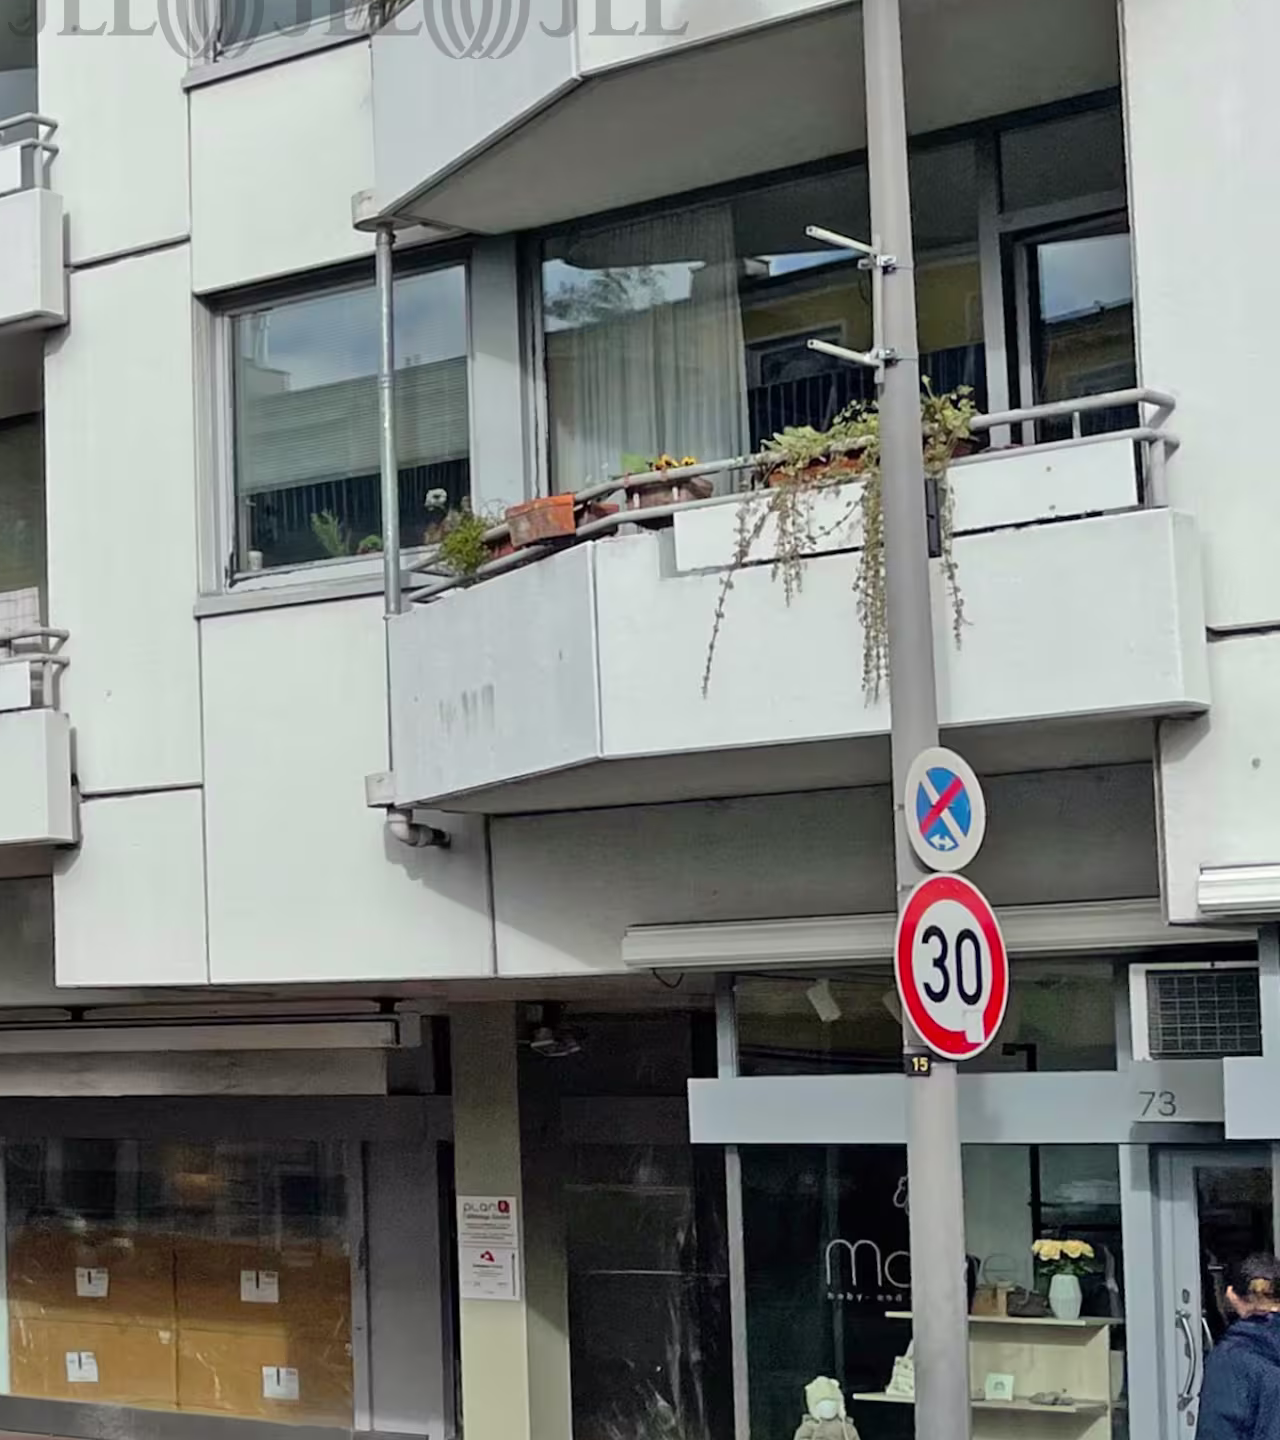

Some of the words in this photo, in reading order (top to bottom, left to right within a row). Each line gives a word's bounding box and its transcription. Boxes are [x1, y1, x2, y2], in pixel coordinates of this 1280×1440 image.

[922, 924, 983, 1006] 30
[912, 1056, 929, 1072] 15
[1138, 1091, 1177, 1117] 73
